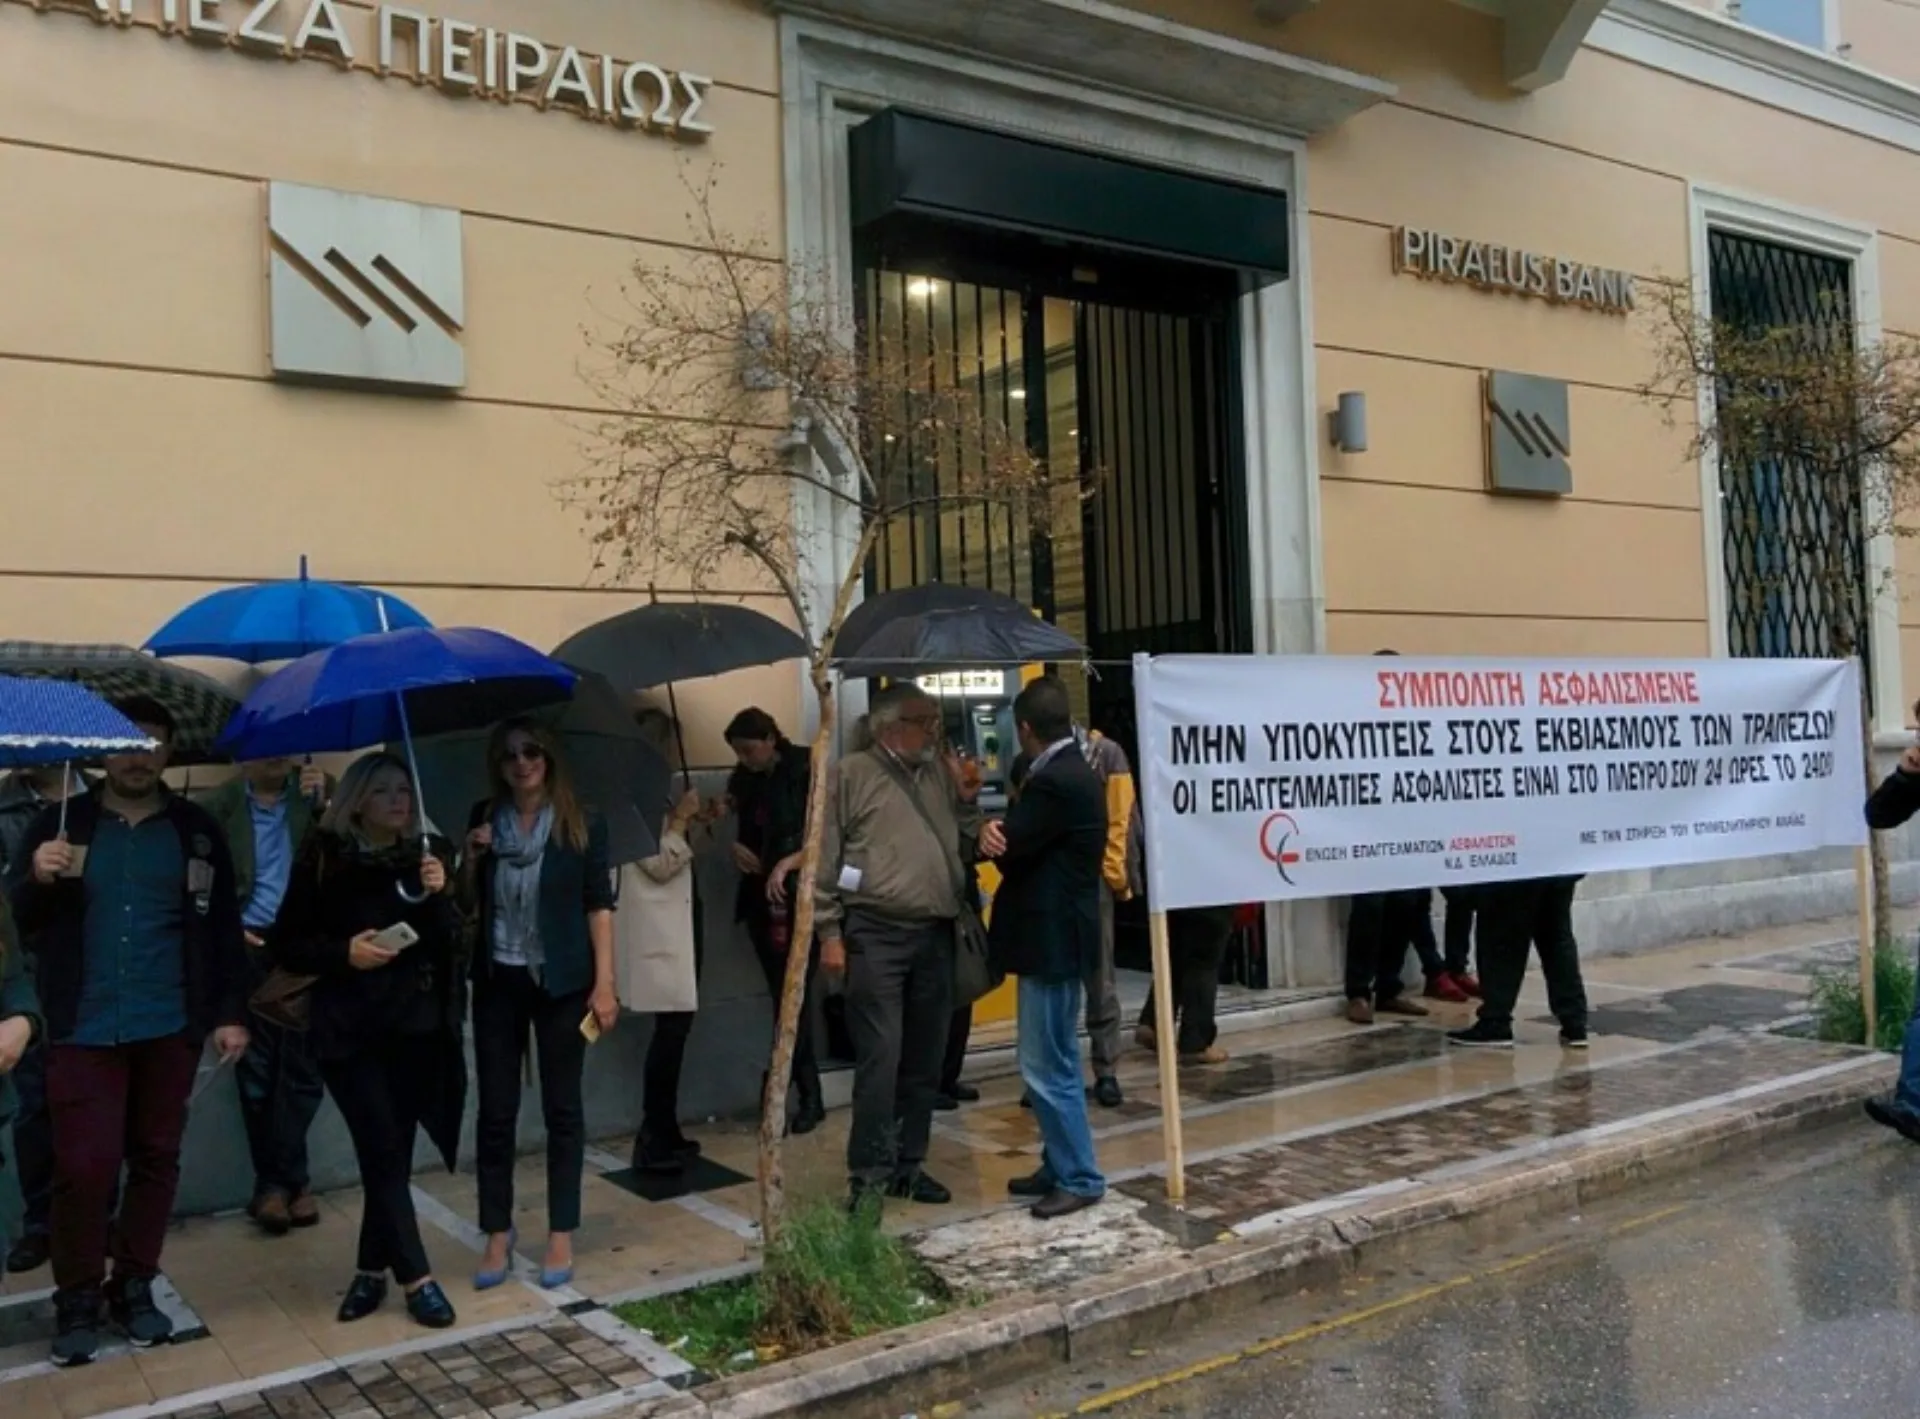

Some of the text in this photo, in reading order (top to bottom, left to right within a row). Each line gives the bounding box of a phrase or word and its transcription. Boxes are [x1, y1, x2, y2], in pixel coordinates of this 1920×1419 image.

[380, 4, 714, 133] ΠΕΙΡΑΙΩΣ
[1401, 226, 1636, 311] PIRAEUS BANK
[1378, 671, 1699, 708] ΣΥΜΠΟΛΙΤΗ ΑΣΦΑΛΙΣΜΕΝΕ
[1171, 724, 1246, 765] ΜΗΝ
[1262, 720, 1434, 762] ΥΠΟΚΥΠΤΕΙΣ
[1447, 718, 1523, 755] ΣΤΟΥΣ
[1536, 714, 1681, 751] ΕΚΒΙΑΣΜΟΥΣ
[1690, 714, 1732, 747] ΤΩΝ
[1173, 780, 1196, 814] ΟΙ
[1212, 772, 1381, 812] ΕΠΑΓΓΕΛΜΑΤΙΕΣ
[1392, 766, 1504, 803] ΑΣΦΑΛΙΣΤΕΣ
[1513, 764, 1559, 798] ΕΙΝΑΙ
[1568, 762, 1598, 793] ΣΤΟ
[1607, 760, 1667, 791] ΠΛΕΥΡΟ
[1671, 758, 1698, 788] ΣΟΥ
[1704, 757, 1723, 786] 24
[1729, 755, 1770, 784] ΩΡΕΣ
[1772, 753, 1796, 781] ΤΟ
